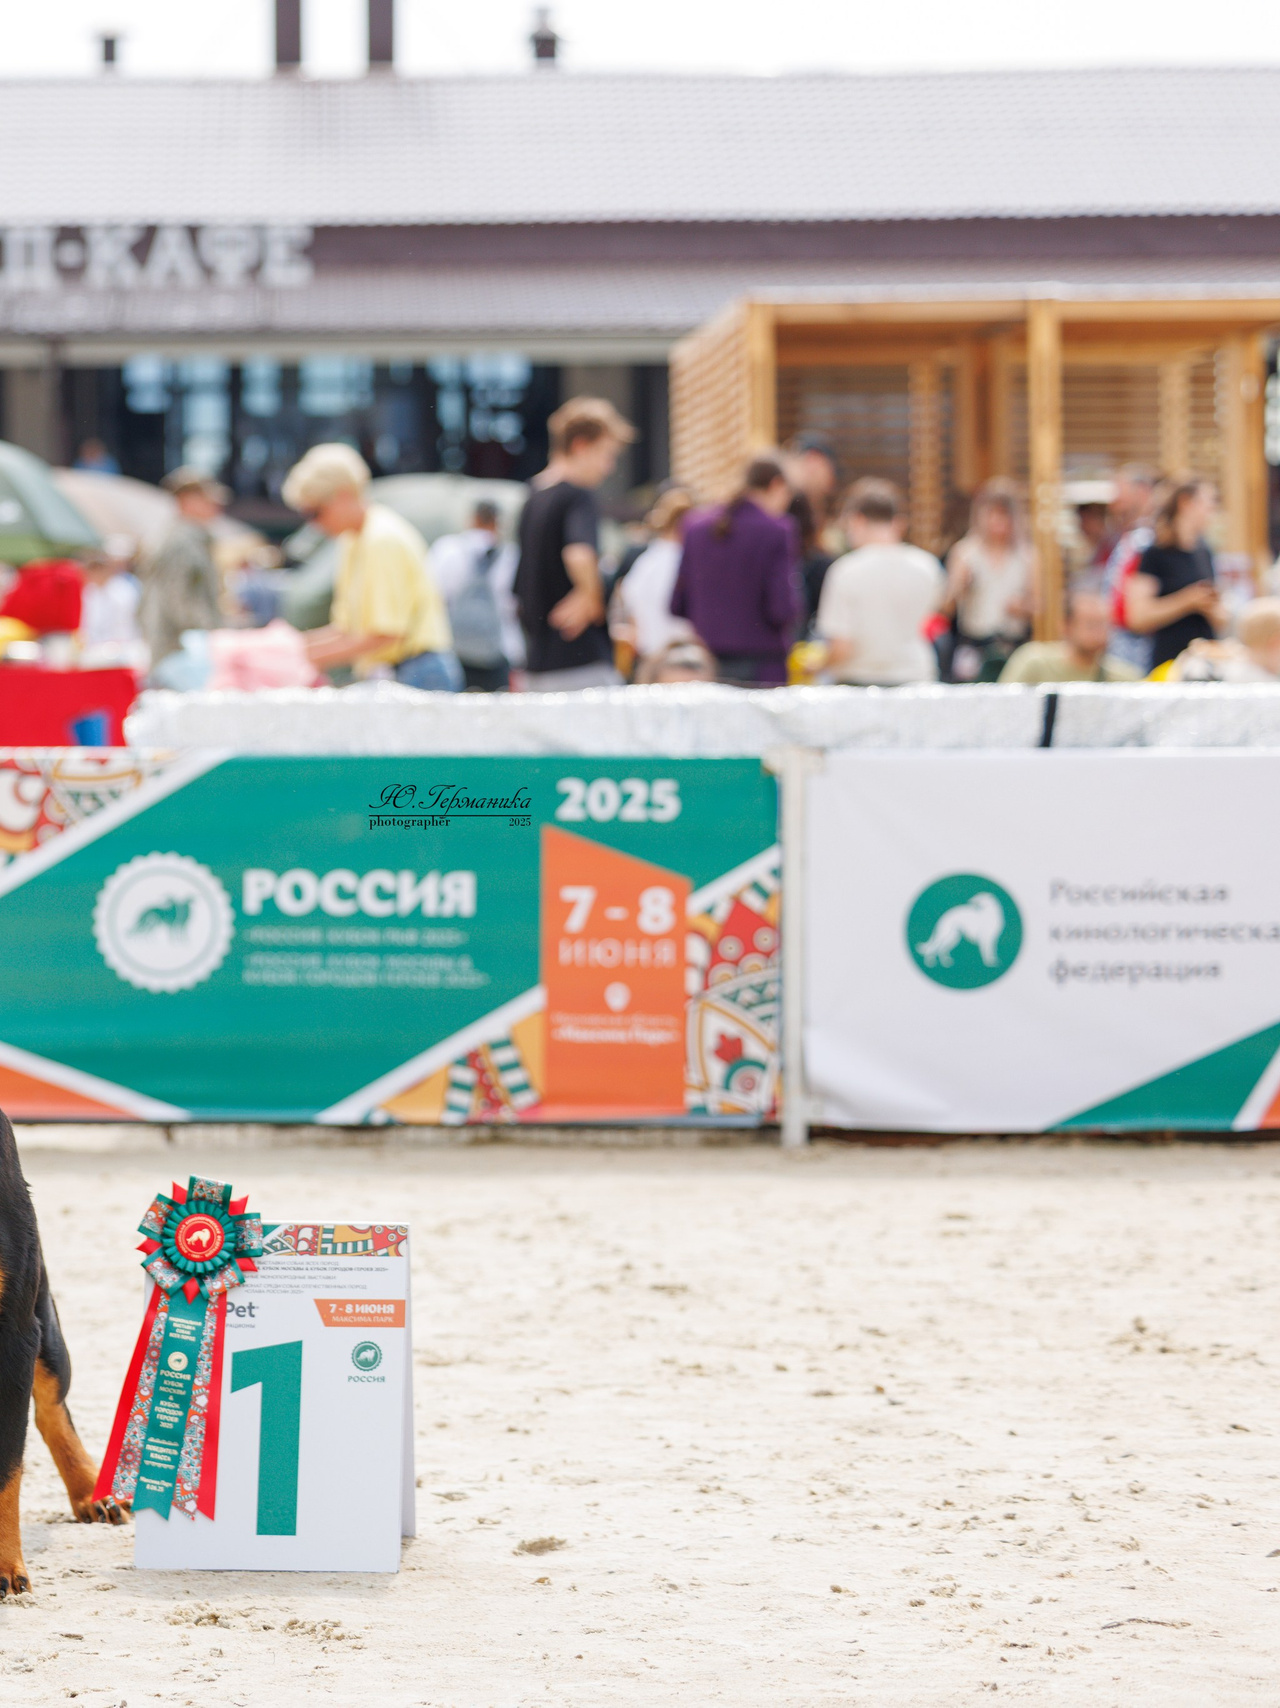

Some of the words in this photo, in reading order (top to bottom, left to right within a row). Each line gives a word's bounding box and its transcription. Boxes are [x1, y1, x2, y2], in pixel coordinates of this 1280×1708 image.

[555, 778, 681, 822] 2025
[242, 868, 477, 917] РОССИЯ
[1049, 876, 1228, 906] Российская
[559, 885, 598, 934] 7
[636, 885, 676, 934] 8
[1049, 922, 1280, 945] кинологическа
[559, 940, 677, 968] ИЮНЯ
[1048, 955, 1223, 987] федерация
[329, 1304, 337, 1313] 7
[345, 1304, 353, 1314] 8
[355, 1304, 394, 1314] ИЮНЯ
[160, 1370, 191, 1380] РОССИЯ
[230, 1340, 303, 1536] 1
